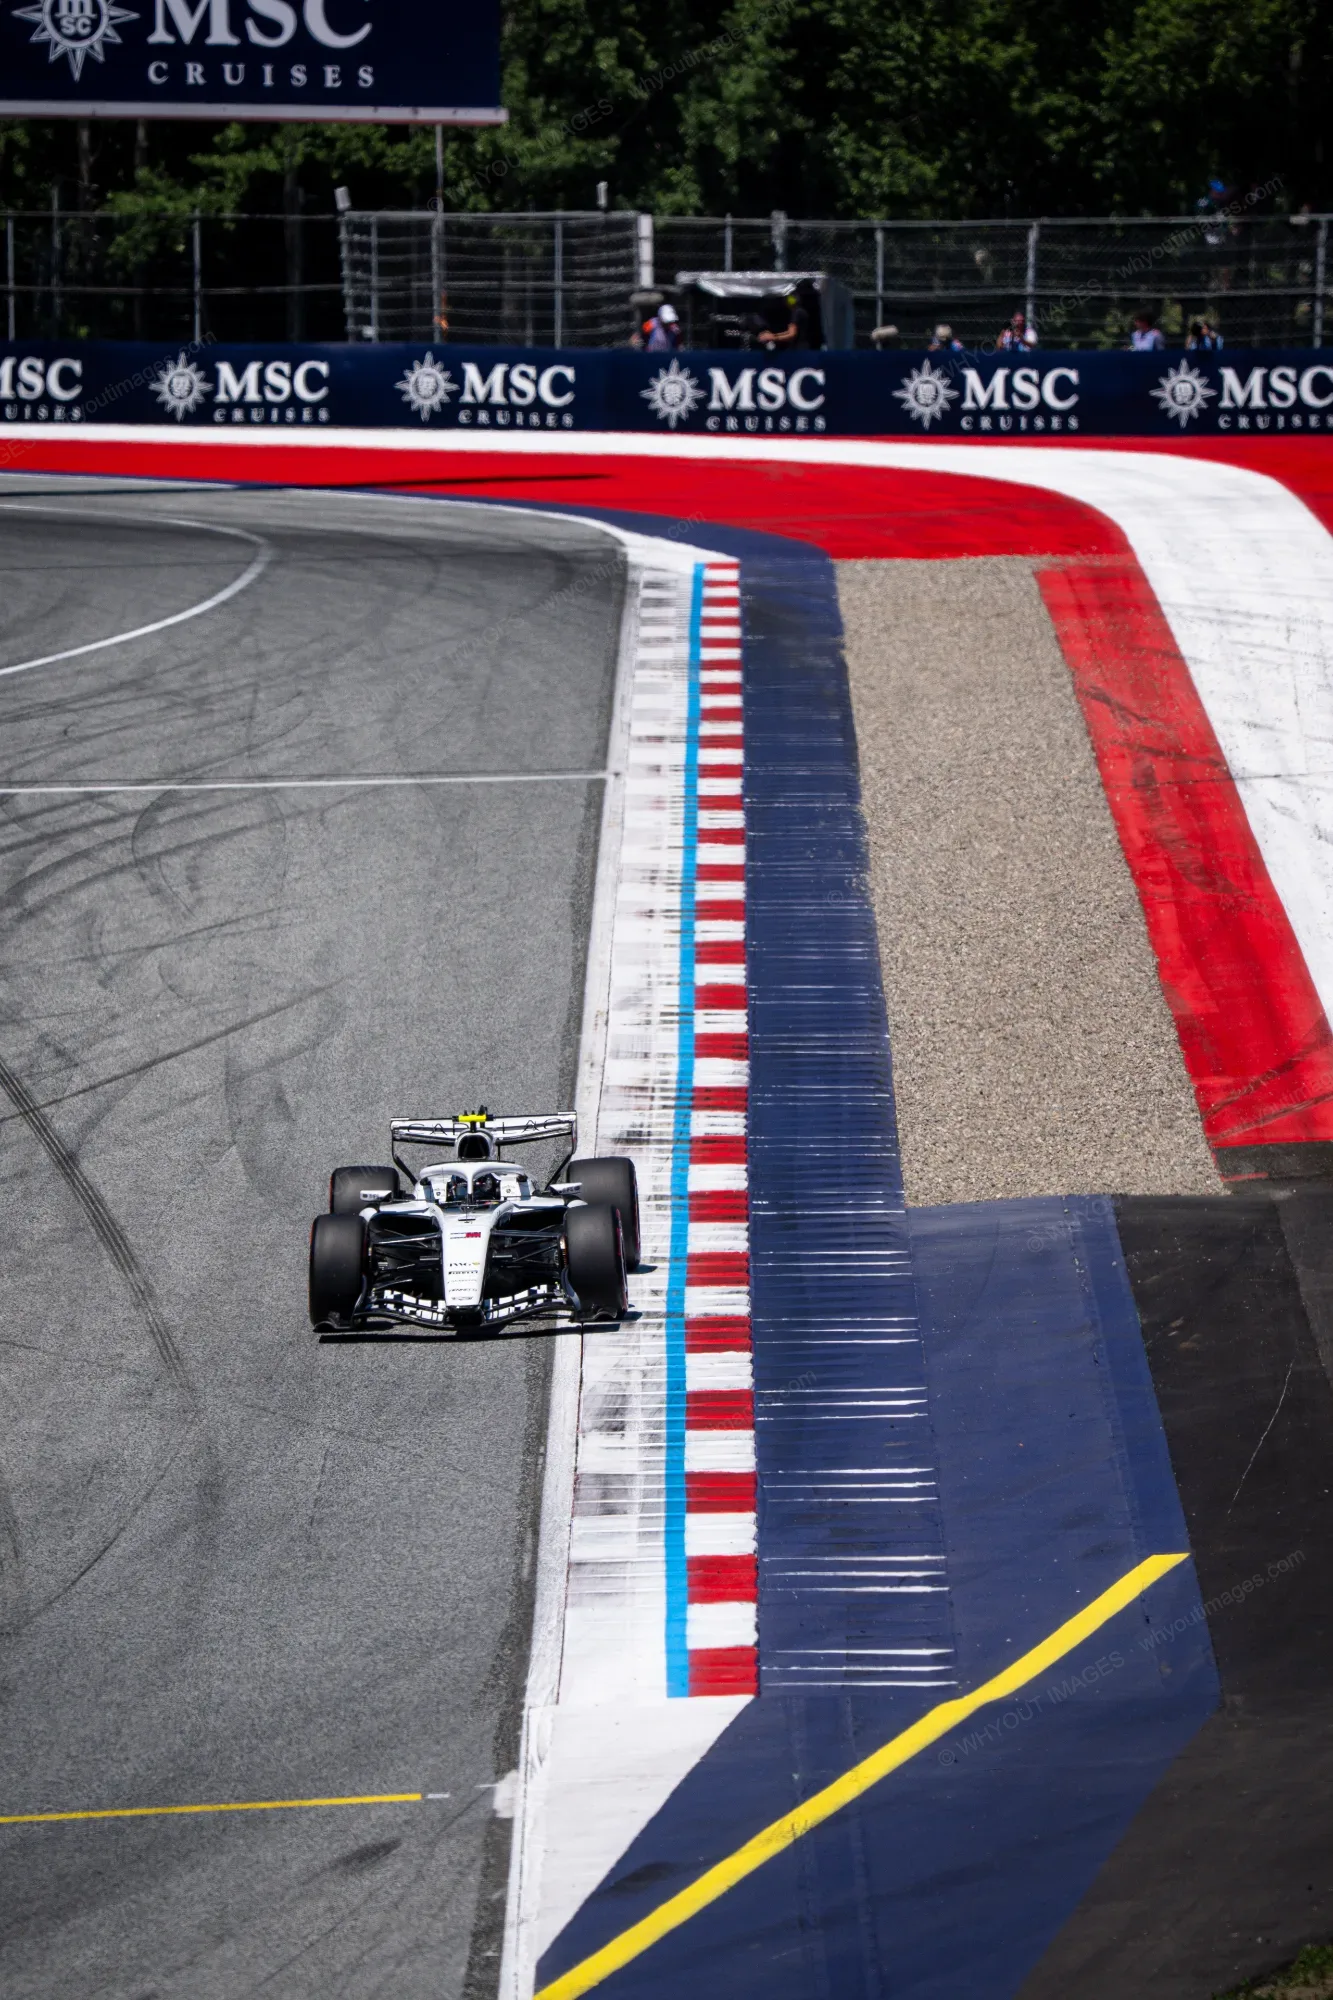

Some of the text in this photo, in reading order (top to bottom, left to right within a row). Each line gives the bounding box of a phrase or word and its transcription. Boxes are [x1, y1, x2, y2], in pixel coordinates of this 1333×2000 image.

[146, 0, 373, 49] MSC
[147, 61, 375, 88] CRUISES
[214, 361, 330, 403] MSC
[459, 362, 577, 407] MSC
[707, 367, 826, 411] MSC
[960, 367, 1080, 410] MSC
[1218, 365, 1333, 408] MSC
[213, 407, 331, 423] CRUISES
[458, 409, 575, 428] CRUISES
[706, 415, 827, 431] CRUISES
[960, 415, 1080, 431] CRUISES
